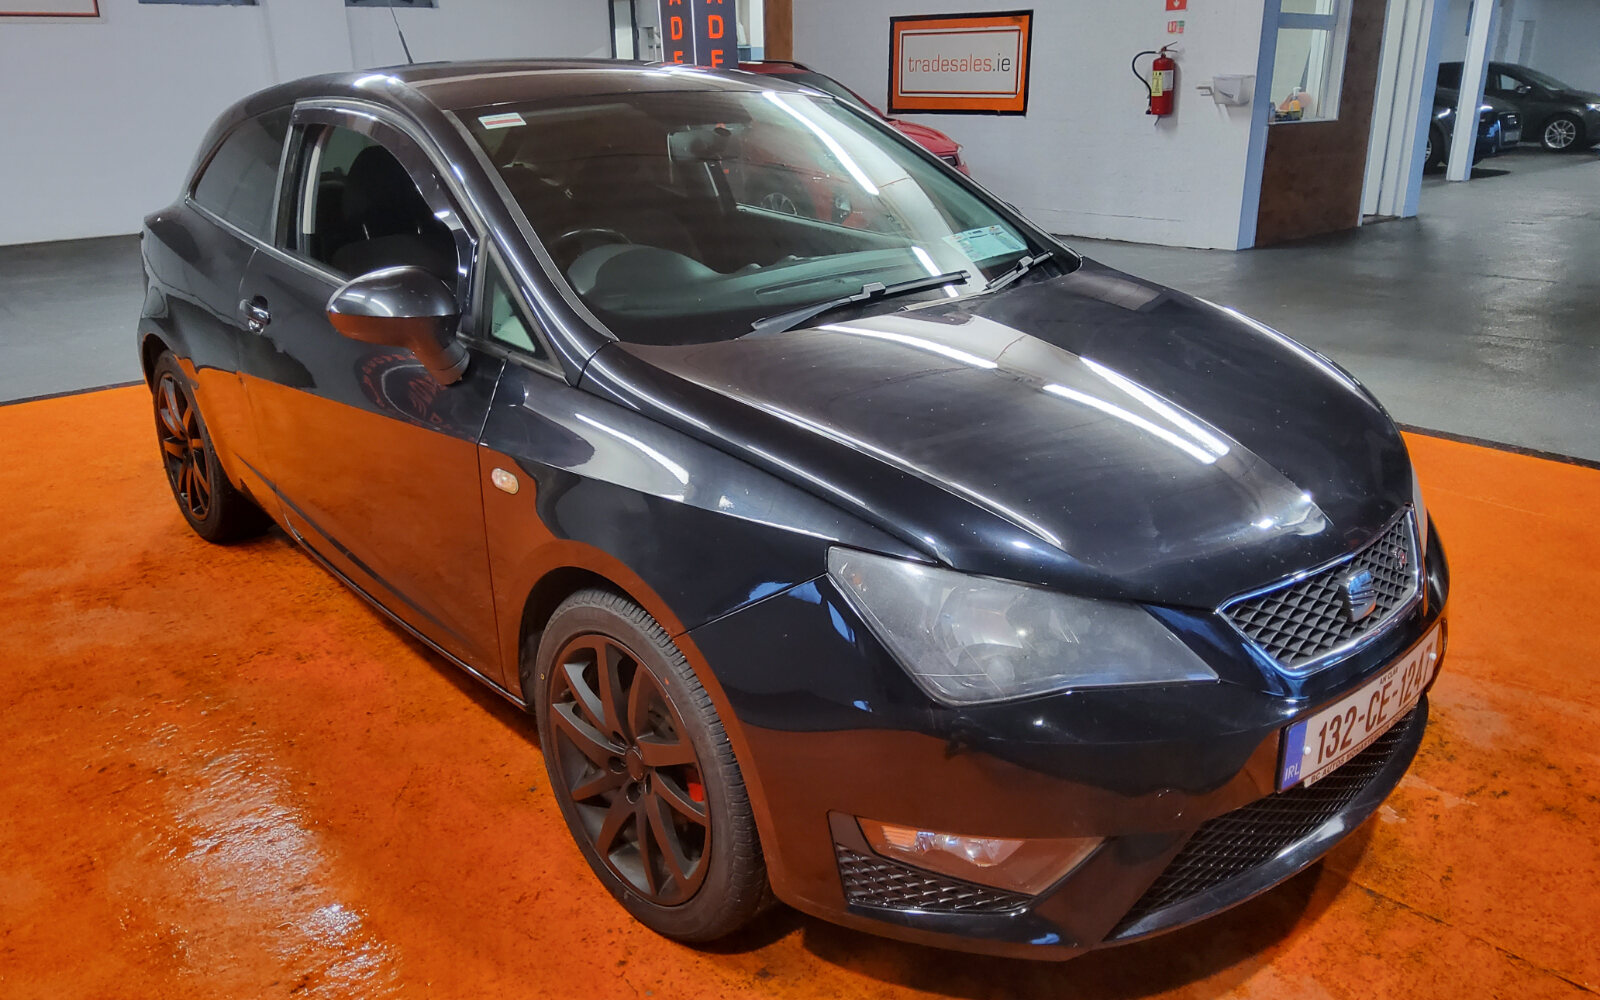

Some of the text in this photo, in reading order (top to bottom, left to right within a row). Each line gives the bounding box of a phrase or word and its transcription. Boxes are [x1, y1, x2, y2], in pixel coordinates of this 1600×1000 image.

[669, 0, 684, 64] DE
[706, 0, 724, 69] DE
[908, 53, 1011, 73] tradesales.ie
[1317, 642, 1434, 765] 132-CE-1247
[1284, 764, 1300, 782] IRL
[1322, 756, 1346, 776] AUTOS
